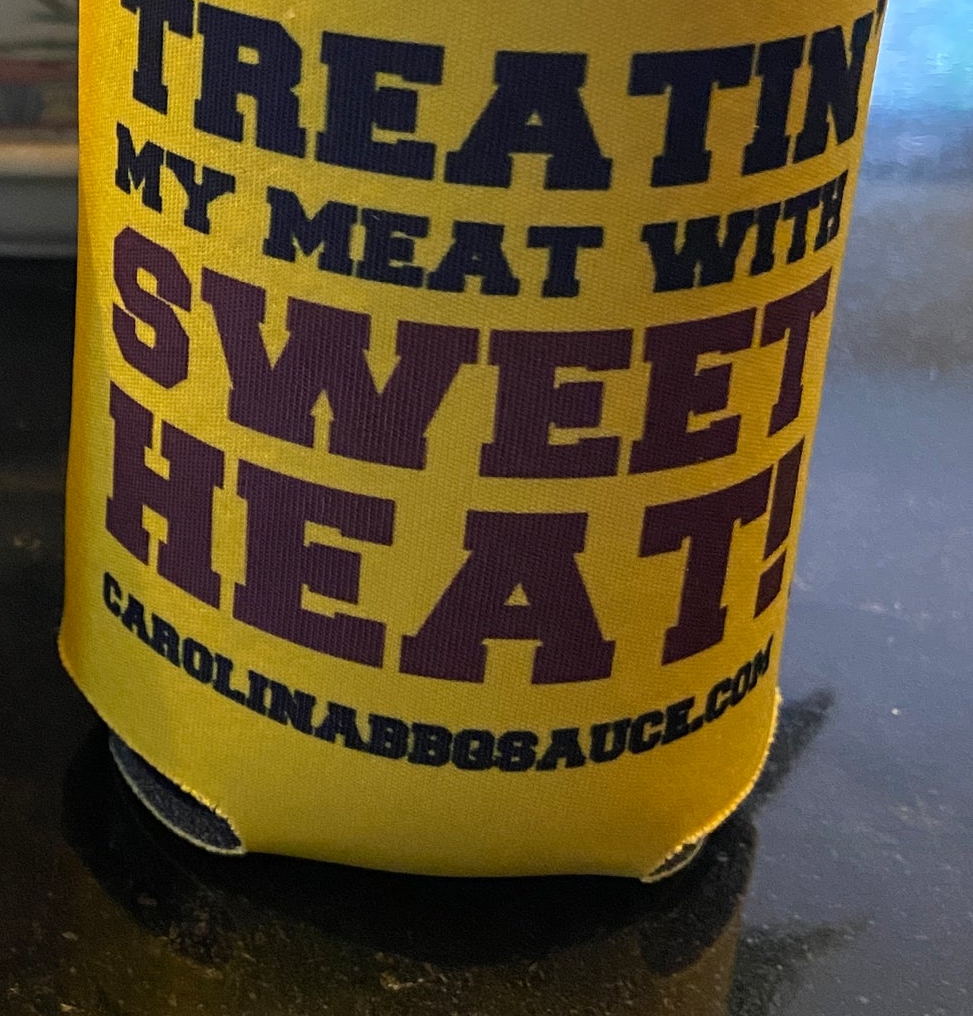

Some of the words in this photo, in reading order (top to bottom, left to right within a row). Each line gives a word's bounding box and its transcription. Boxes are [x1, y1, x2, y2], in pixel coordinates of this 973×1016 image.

[114, 121, 237, 235] MY
[261, 186, 604, 298] MEAT
[641, 170, 849, 294] WITH
[111, 226, 833, 480] SWEET
[105, 380, 807, 686] HEAT!
[102, 571, 776, 772] CAROLINABBQSAUCE.COM
